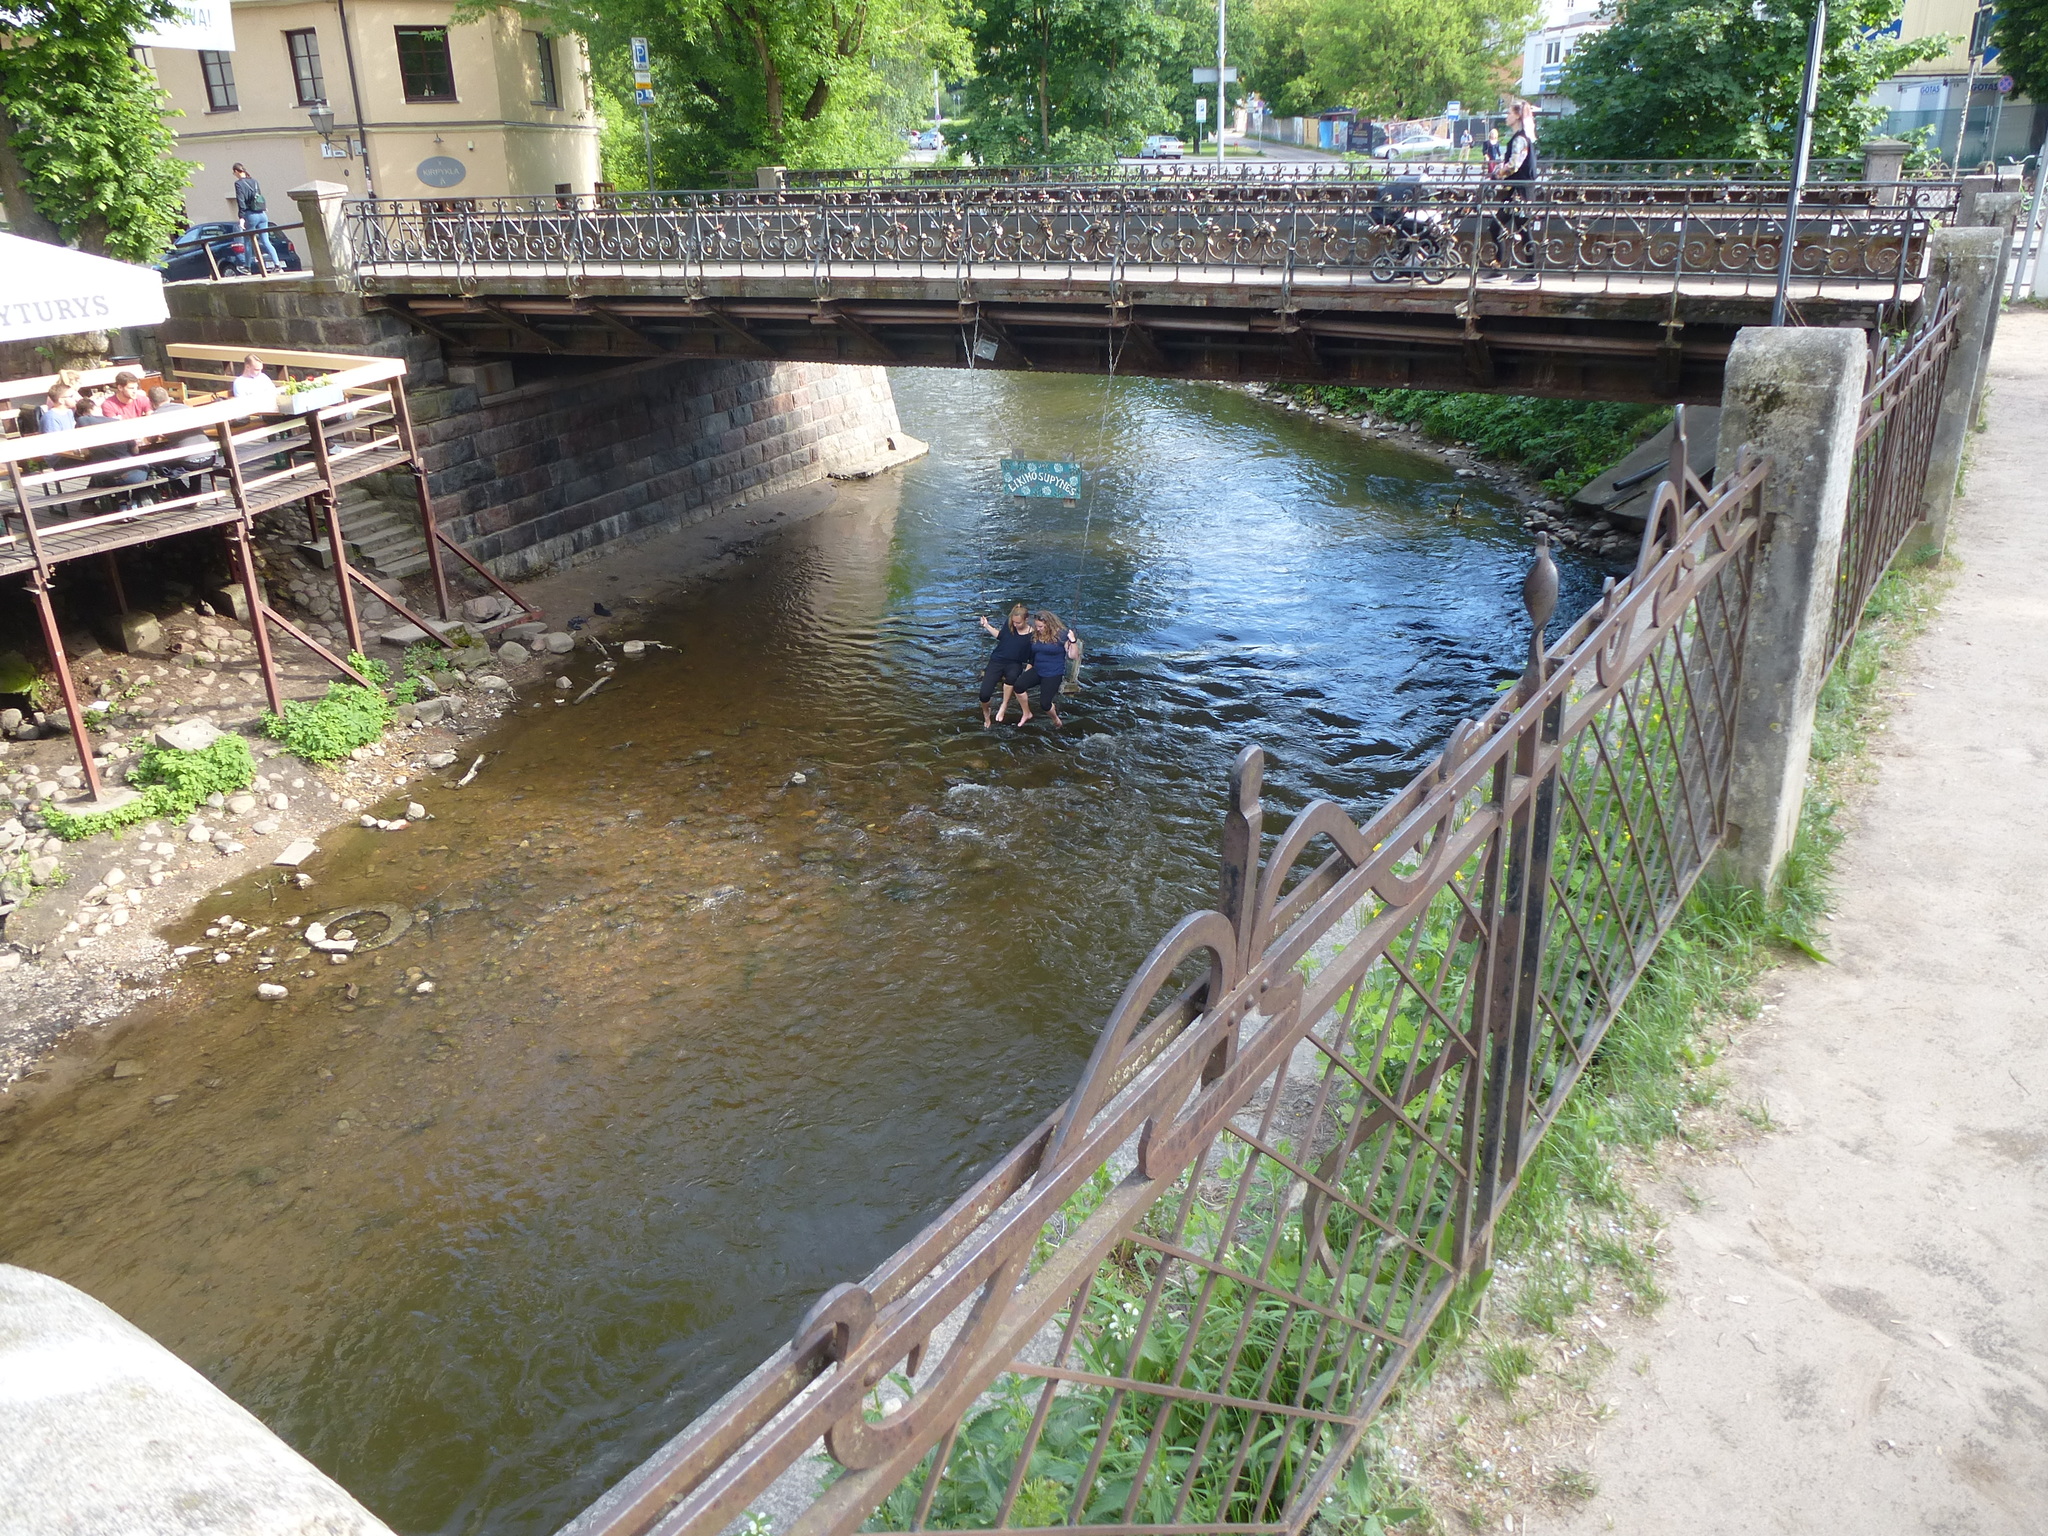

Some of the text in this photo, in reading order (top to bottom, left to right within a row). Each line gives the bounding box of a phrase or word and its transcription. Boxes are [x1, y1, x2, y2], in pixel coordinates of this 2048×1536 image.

[1920, 85, 1940, 94] GOTAS
[1971, 83, 1998, 91] GOTAS
[422, 168, 460, 176] KIRPYKLA
